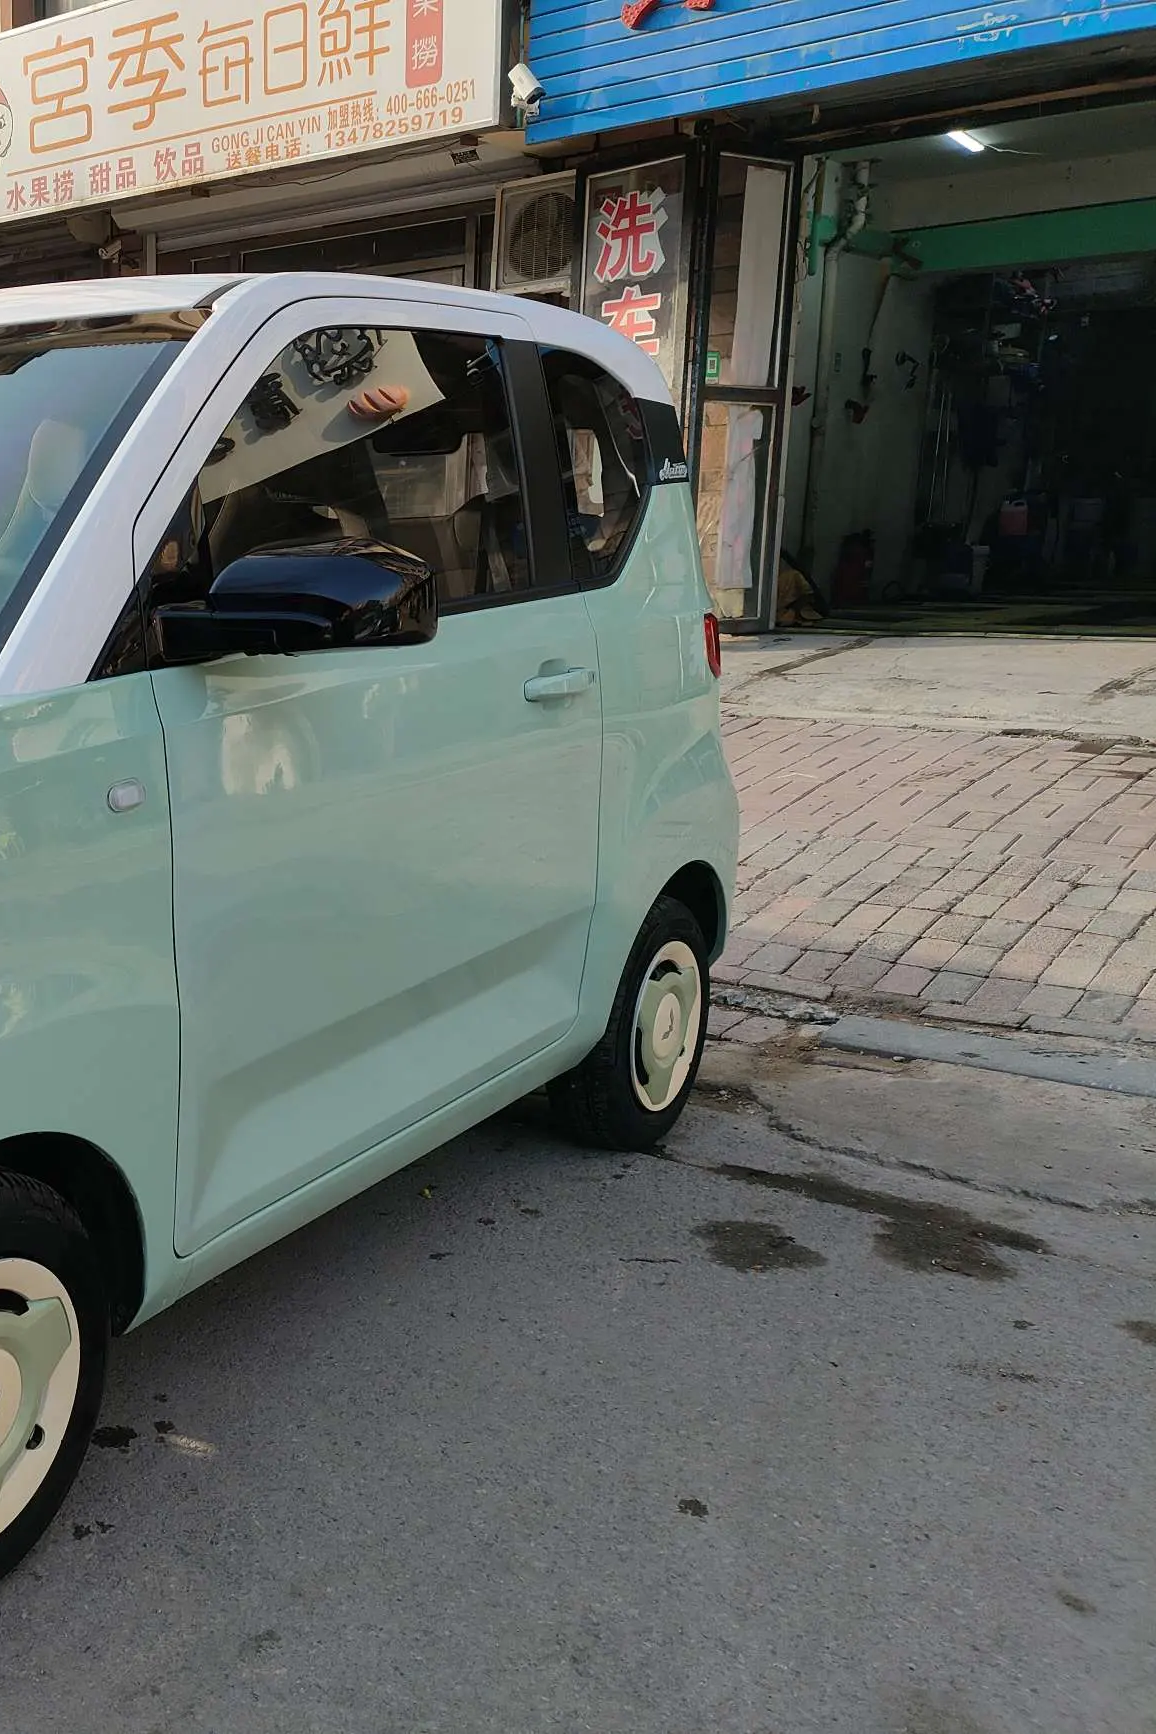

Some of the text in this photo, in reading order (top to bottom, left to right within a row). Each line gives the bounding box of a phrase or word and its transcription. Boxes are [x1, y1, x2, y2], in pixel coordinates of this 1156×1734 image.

[386, 78, 475, 116] 400-666-0251
[211, 115, 321, 154] GONG JI CAN YIN
[324, 106, 463, 149] 13478259719
[6, 142, 204, 212] 水果捞 甜品 饮品
